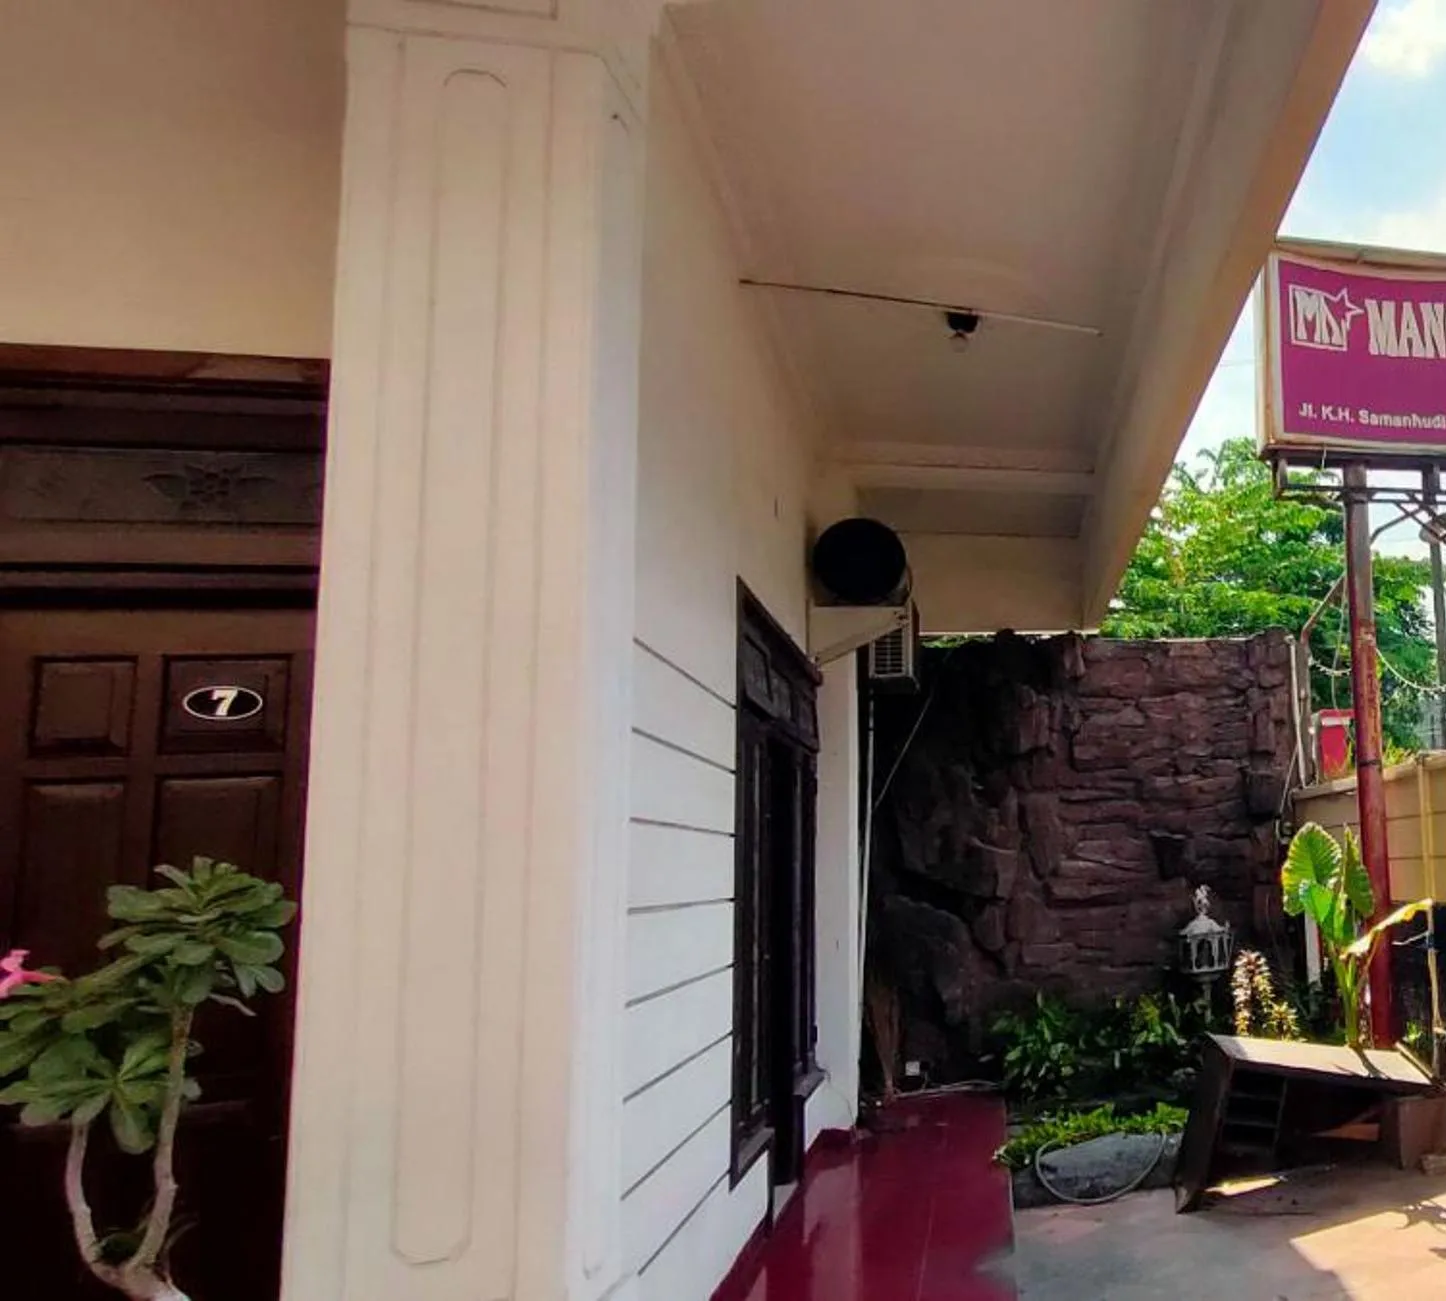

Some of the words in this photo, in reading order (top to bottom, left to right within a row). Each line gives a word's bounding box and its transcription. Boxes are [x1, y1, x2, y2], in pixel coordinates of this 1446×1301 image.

[1321, 405, 1354, 423] K.H.
[1358, 409, 1446, 430] Samanhudi
[211, 688, 239, 716] 7
